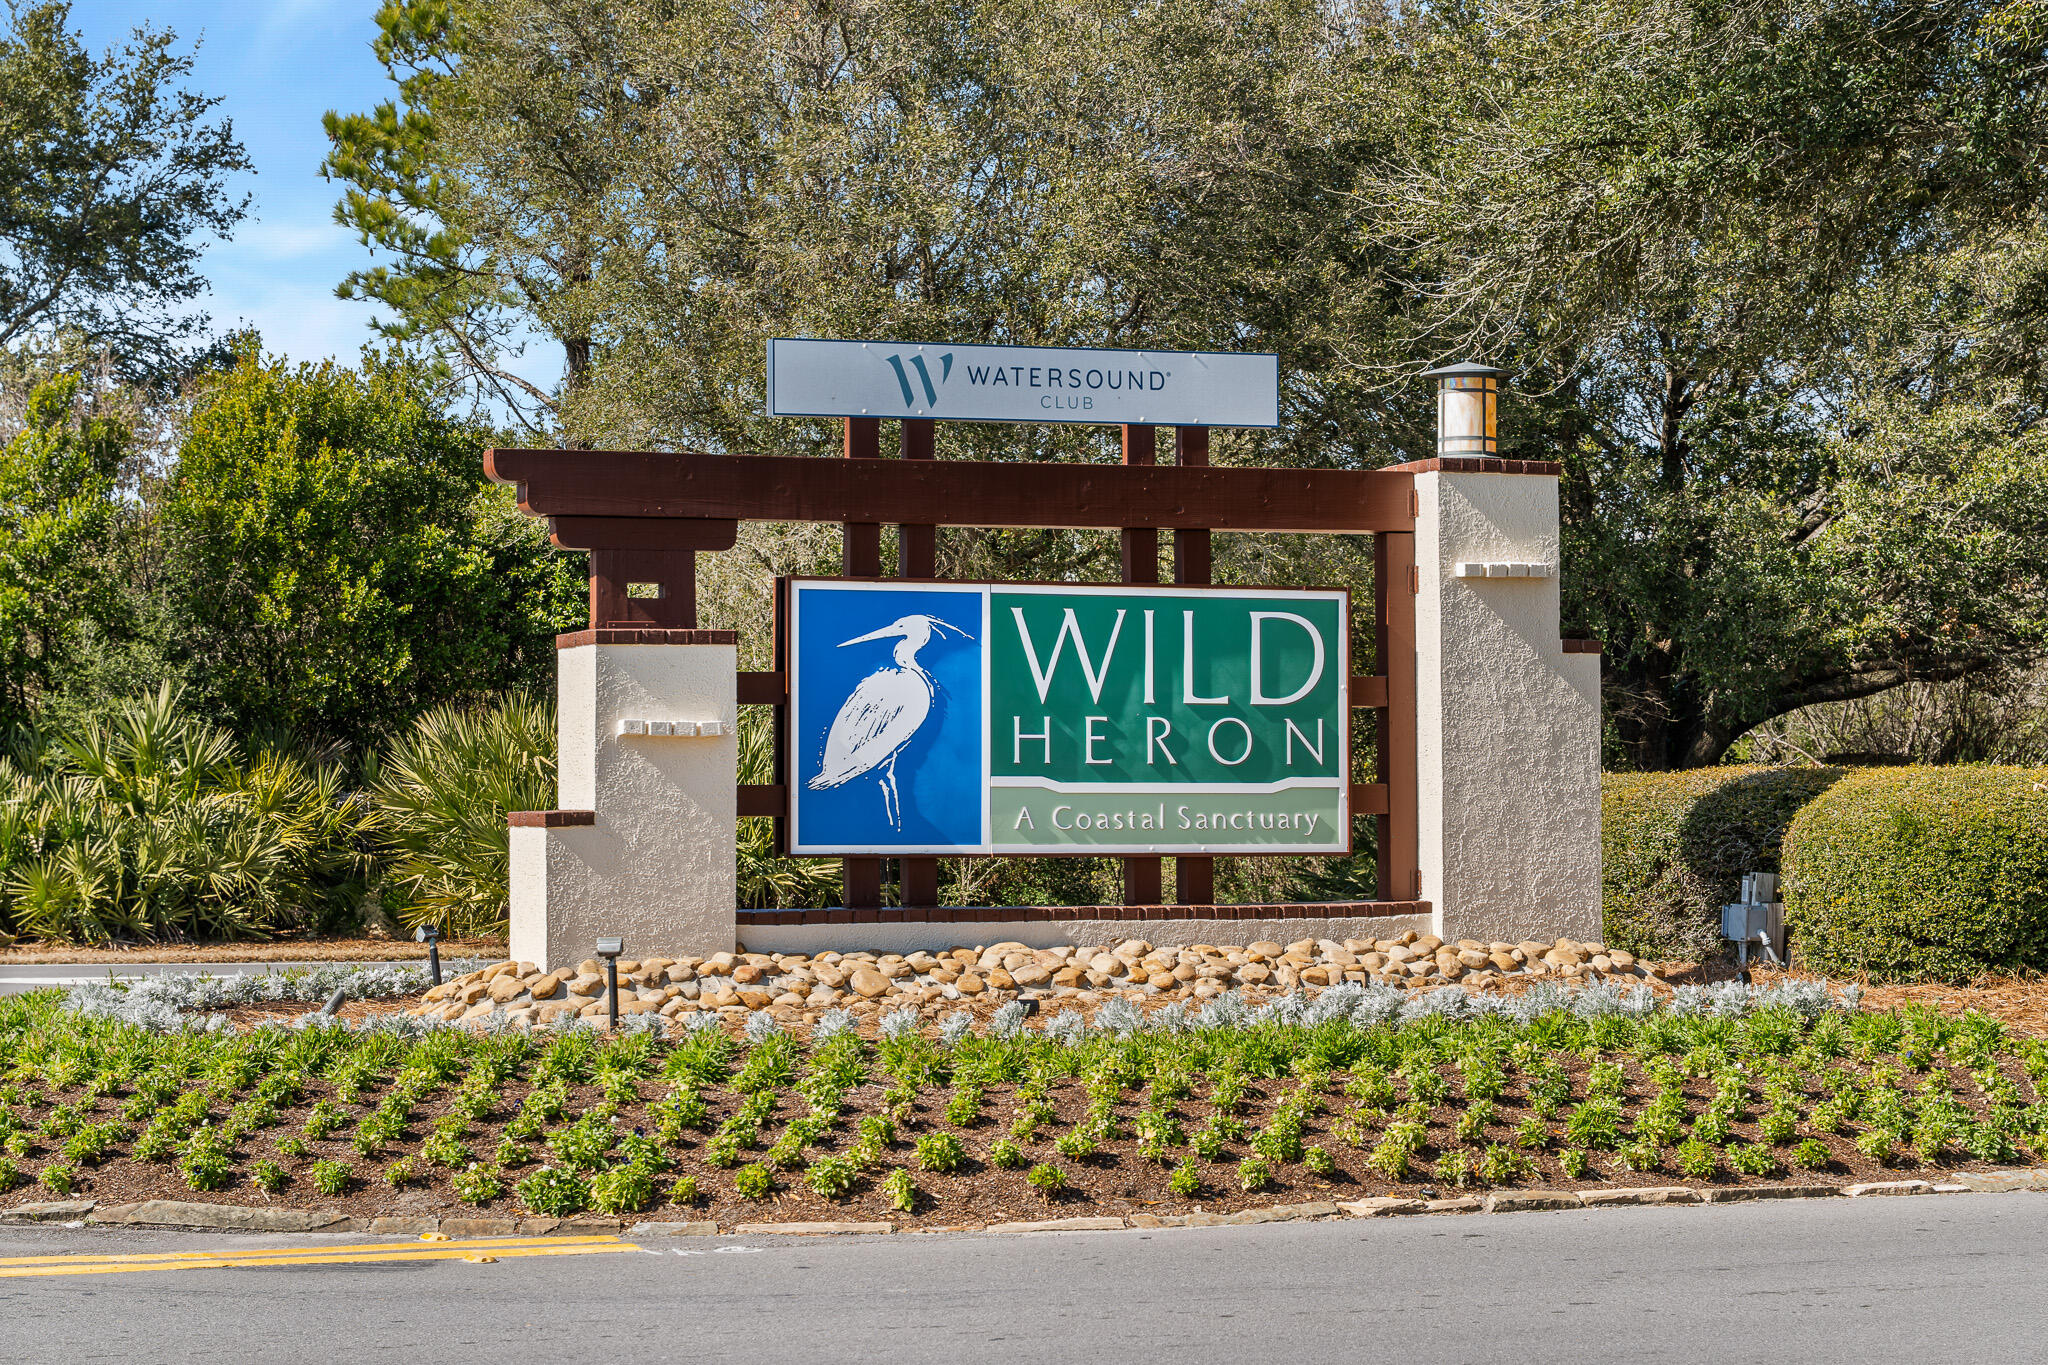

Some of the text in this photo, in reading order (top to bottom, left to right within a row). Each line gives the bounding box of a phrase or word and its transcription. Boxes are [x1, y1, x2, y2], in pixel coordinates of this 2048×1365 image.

[1040, 395, 1094, 410] CLUB
[1010, 607, 1325, 705] WILD
[1013, 716, 1324, 766] HERON
[1013, 803, 1319, 836] A Coastal Sanctuary
